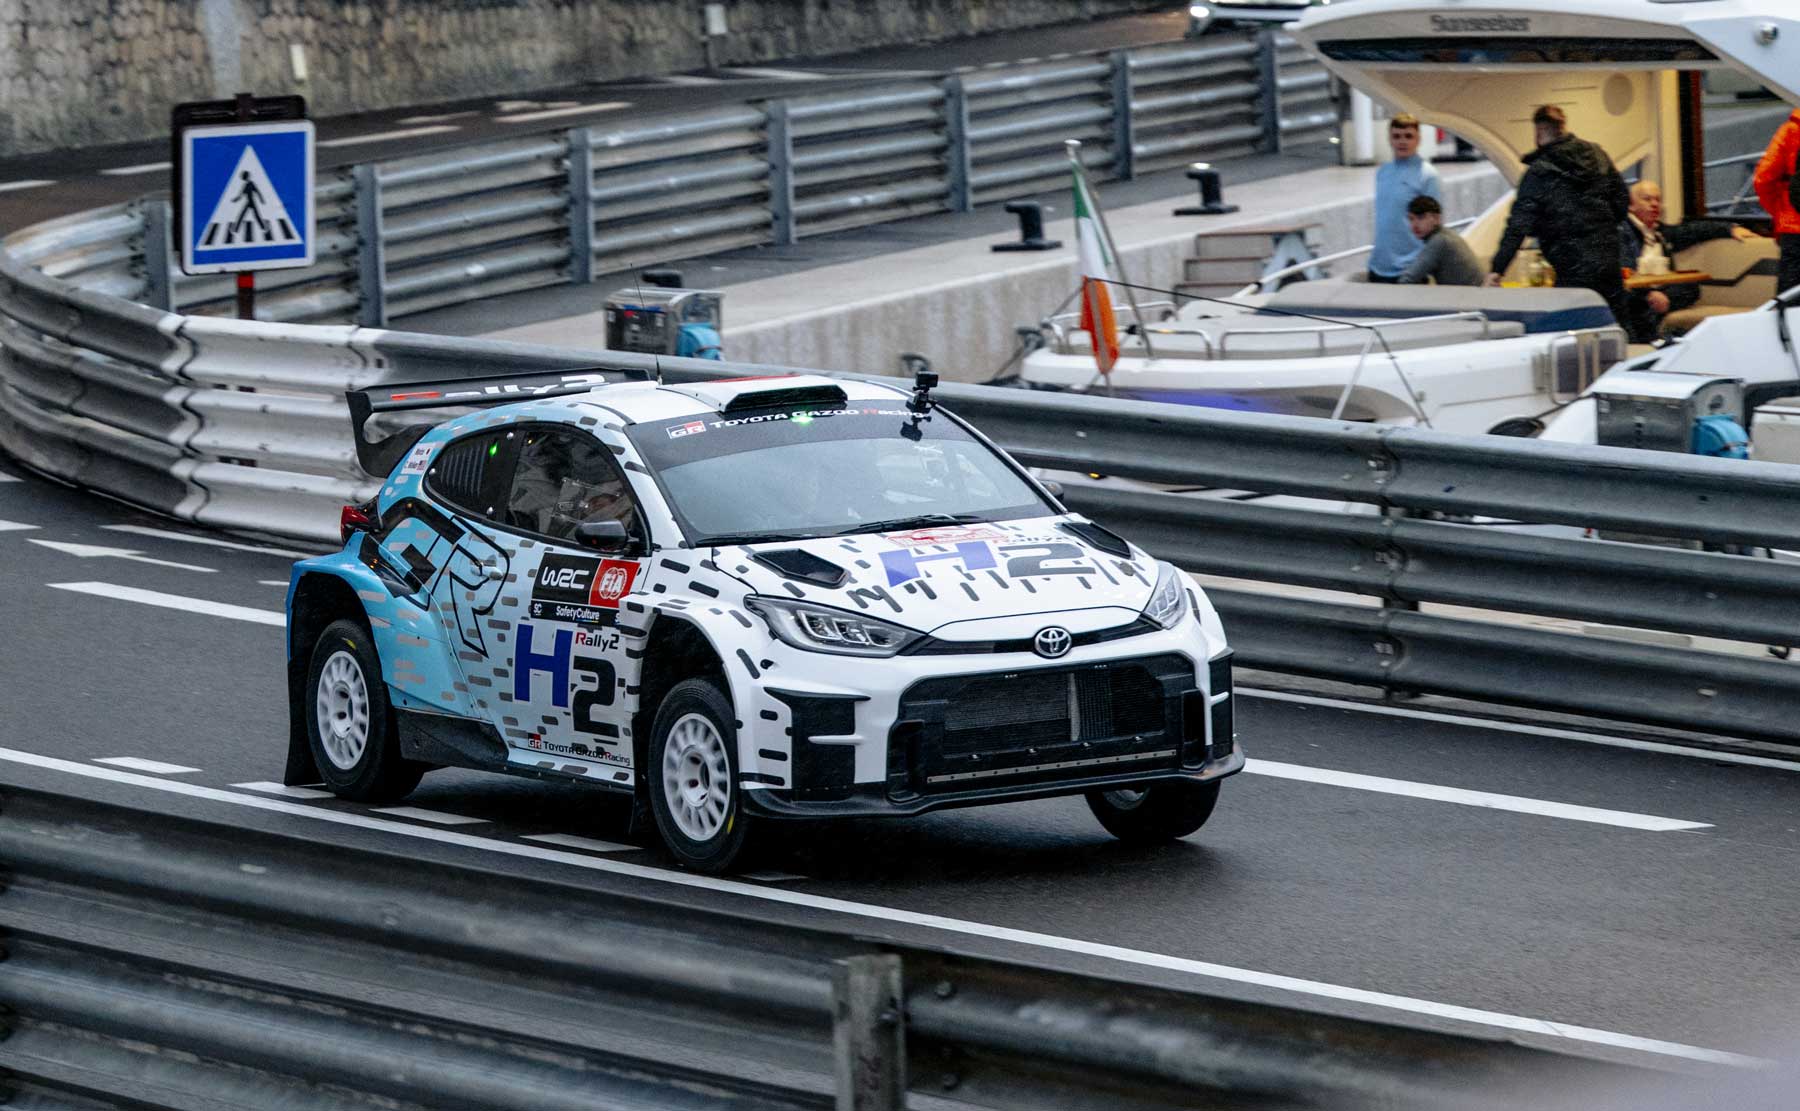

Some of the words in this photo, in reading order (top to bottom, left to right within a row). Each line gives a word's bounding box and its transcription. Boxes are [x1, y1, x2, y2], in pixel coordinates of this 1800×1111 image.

[668, 422, 706, 439] GR
[709, 413, 788, 429] TOYOTA
[791, 409, 859, 420] GAZOO
[541, 566, 590, 590] WRC
[556, 605, 600, 621] SafetyCulture
[575, 632, 619, 652] Rally2
[543, 741, 575, 755] TOYOTA
[603, 751, 631, 767] Racing
